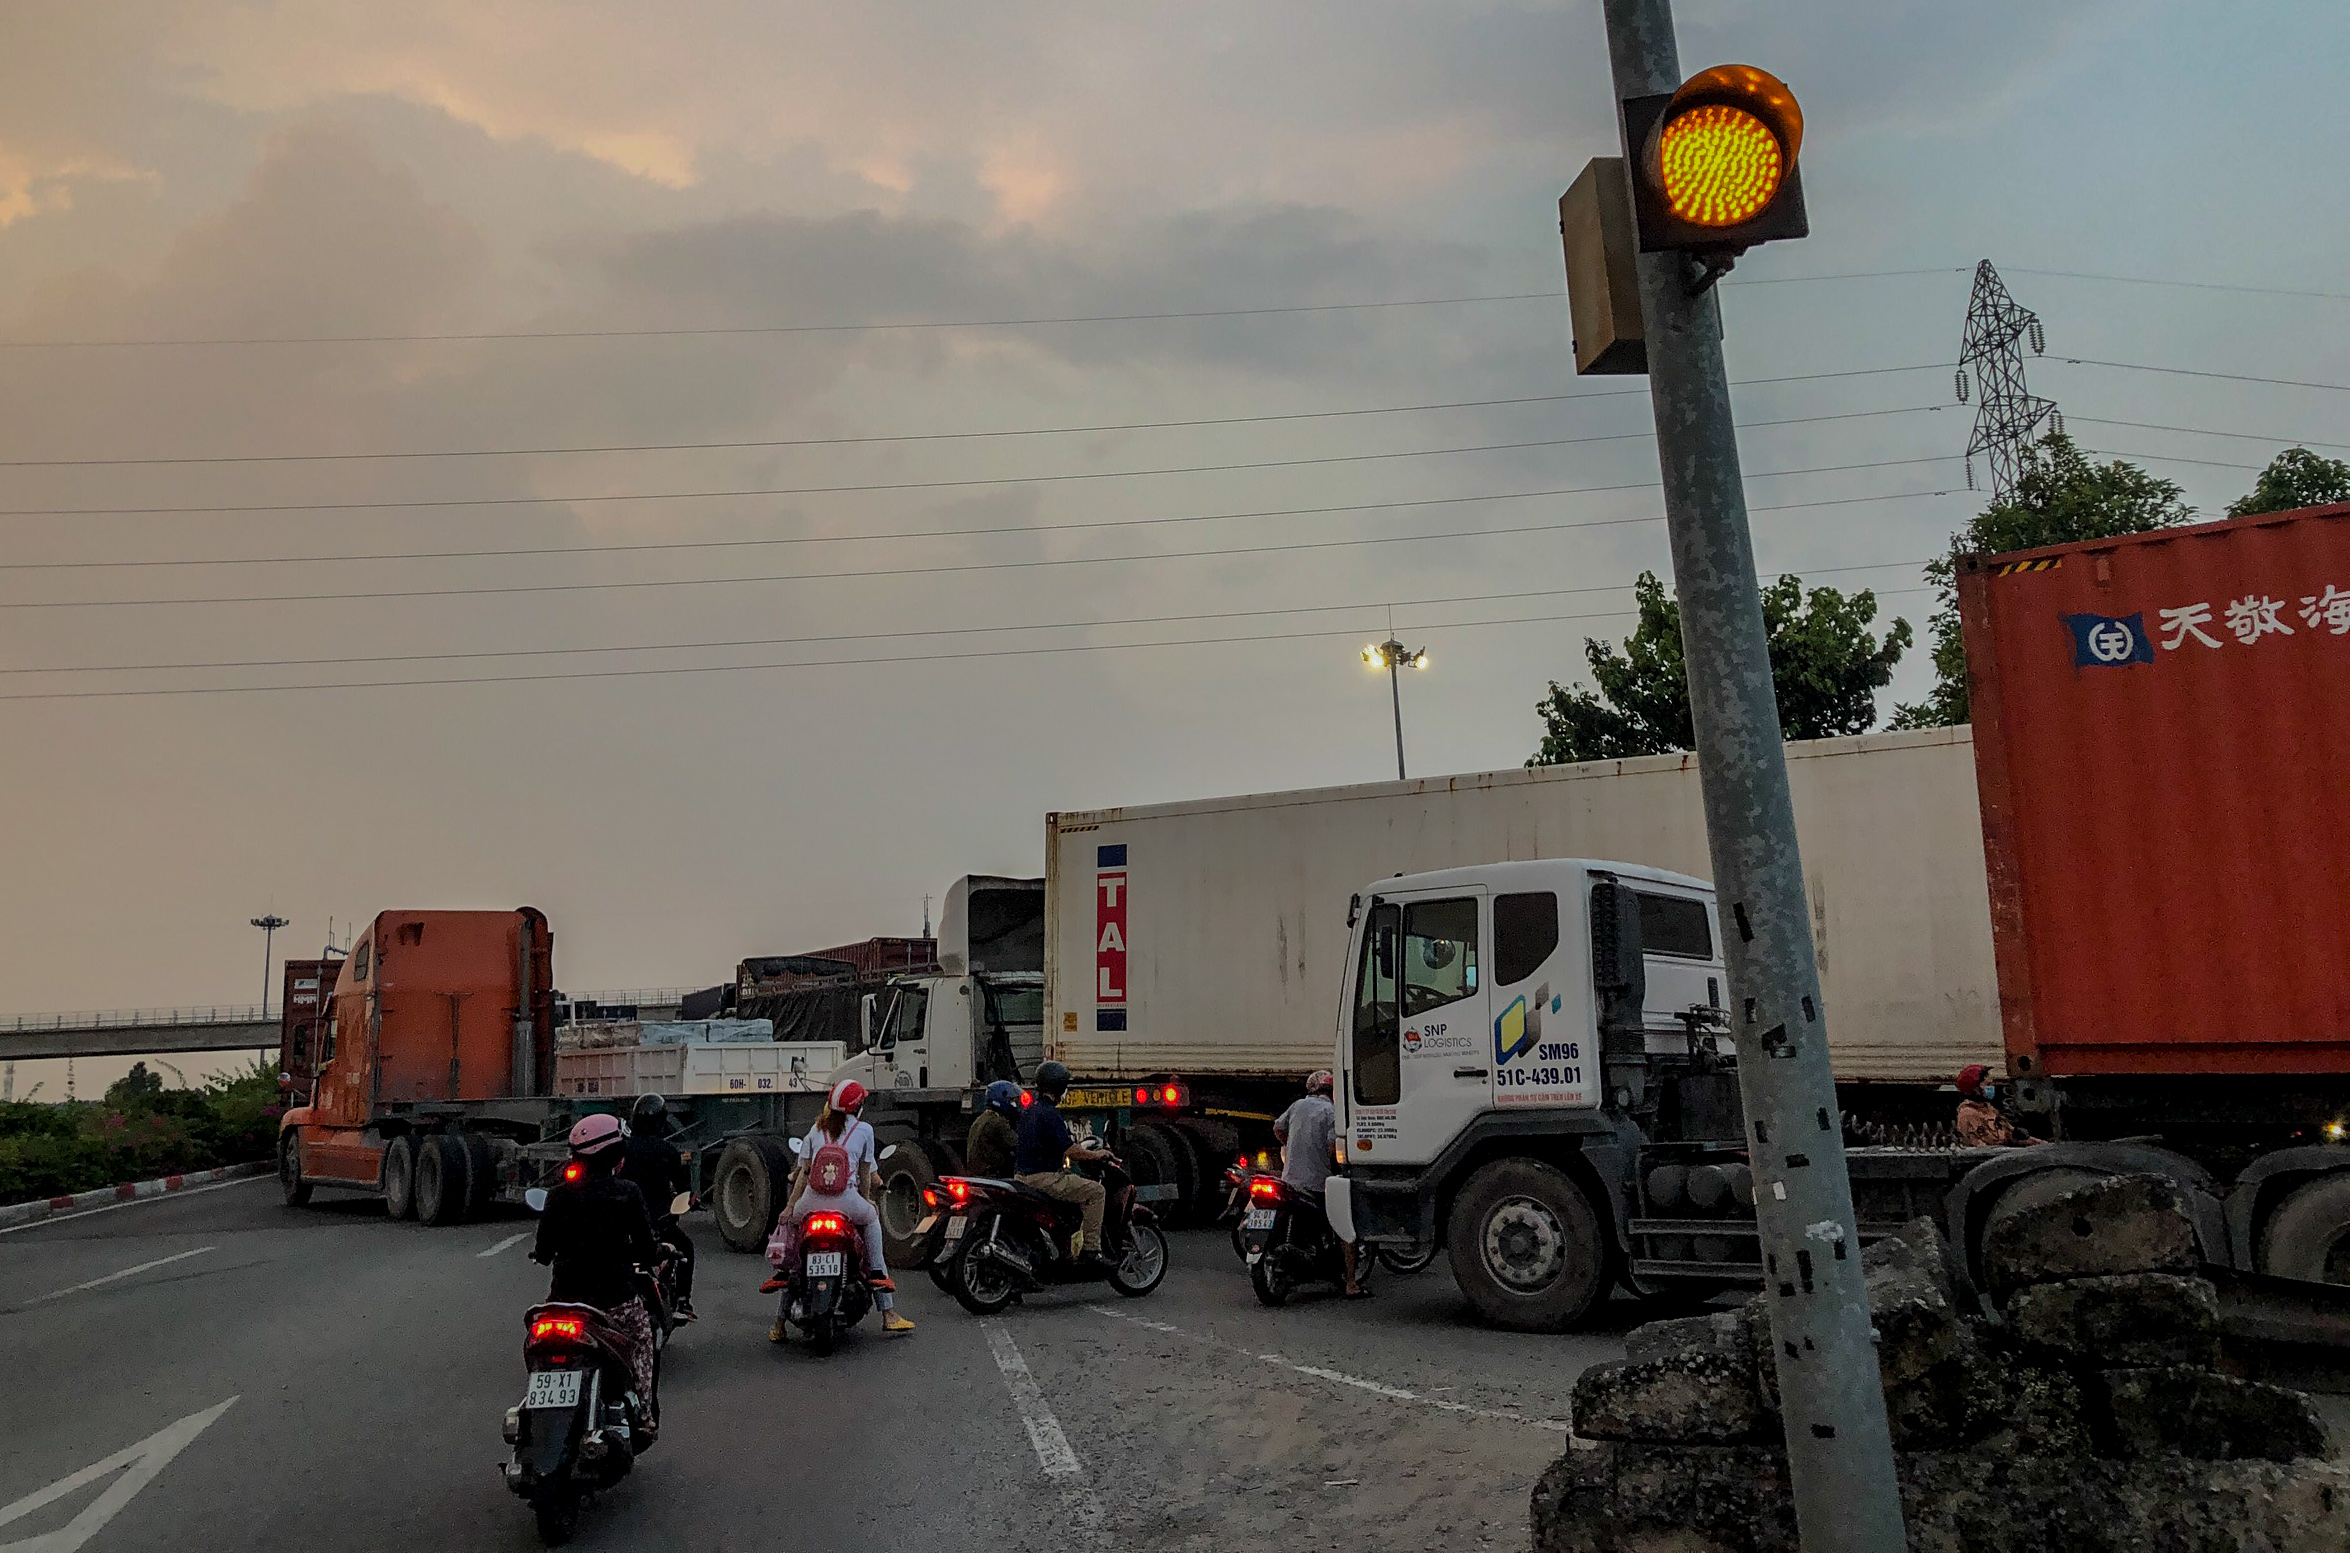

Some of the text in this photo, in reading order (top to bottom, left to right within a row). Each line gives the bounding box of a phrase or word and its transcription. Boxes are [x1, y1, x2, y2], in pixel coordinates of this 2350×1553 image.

[1098, 877, 1125, 998] TAL
[1424, 1024, 1447, 1036] SNP
[1424, 1037, 1472, 1048] LOGISTICS
[1539, 1042, 1578, 1060] SM96
[1497, 1067, 1581, 1085] 51C-439.01
[1085, 1089, 1129, 1105] VEHICLE
[812, 1255, 835, 1264] 83-C1
[536, 1373, 572, 1389] 59-X1
